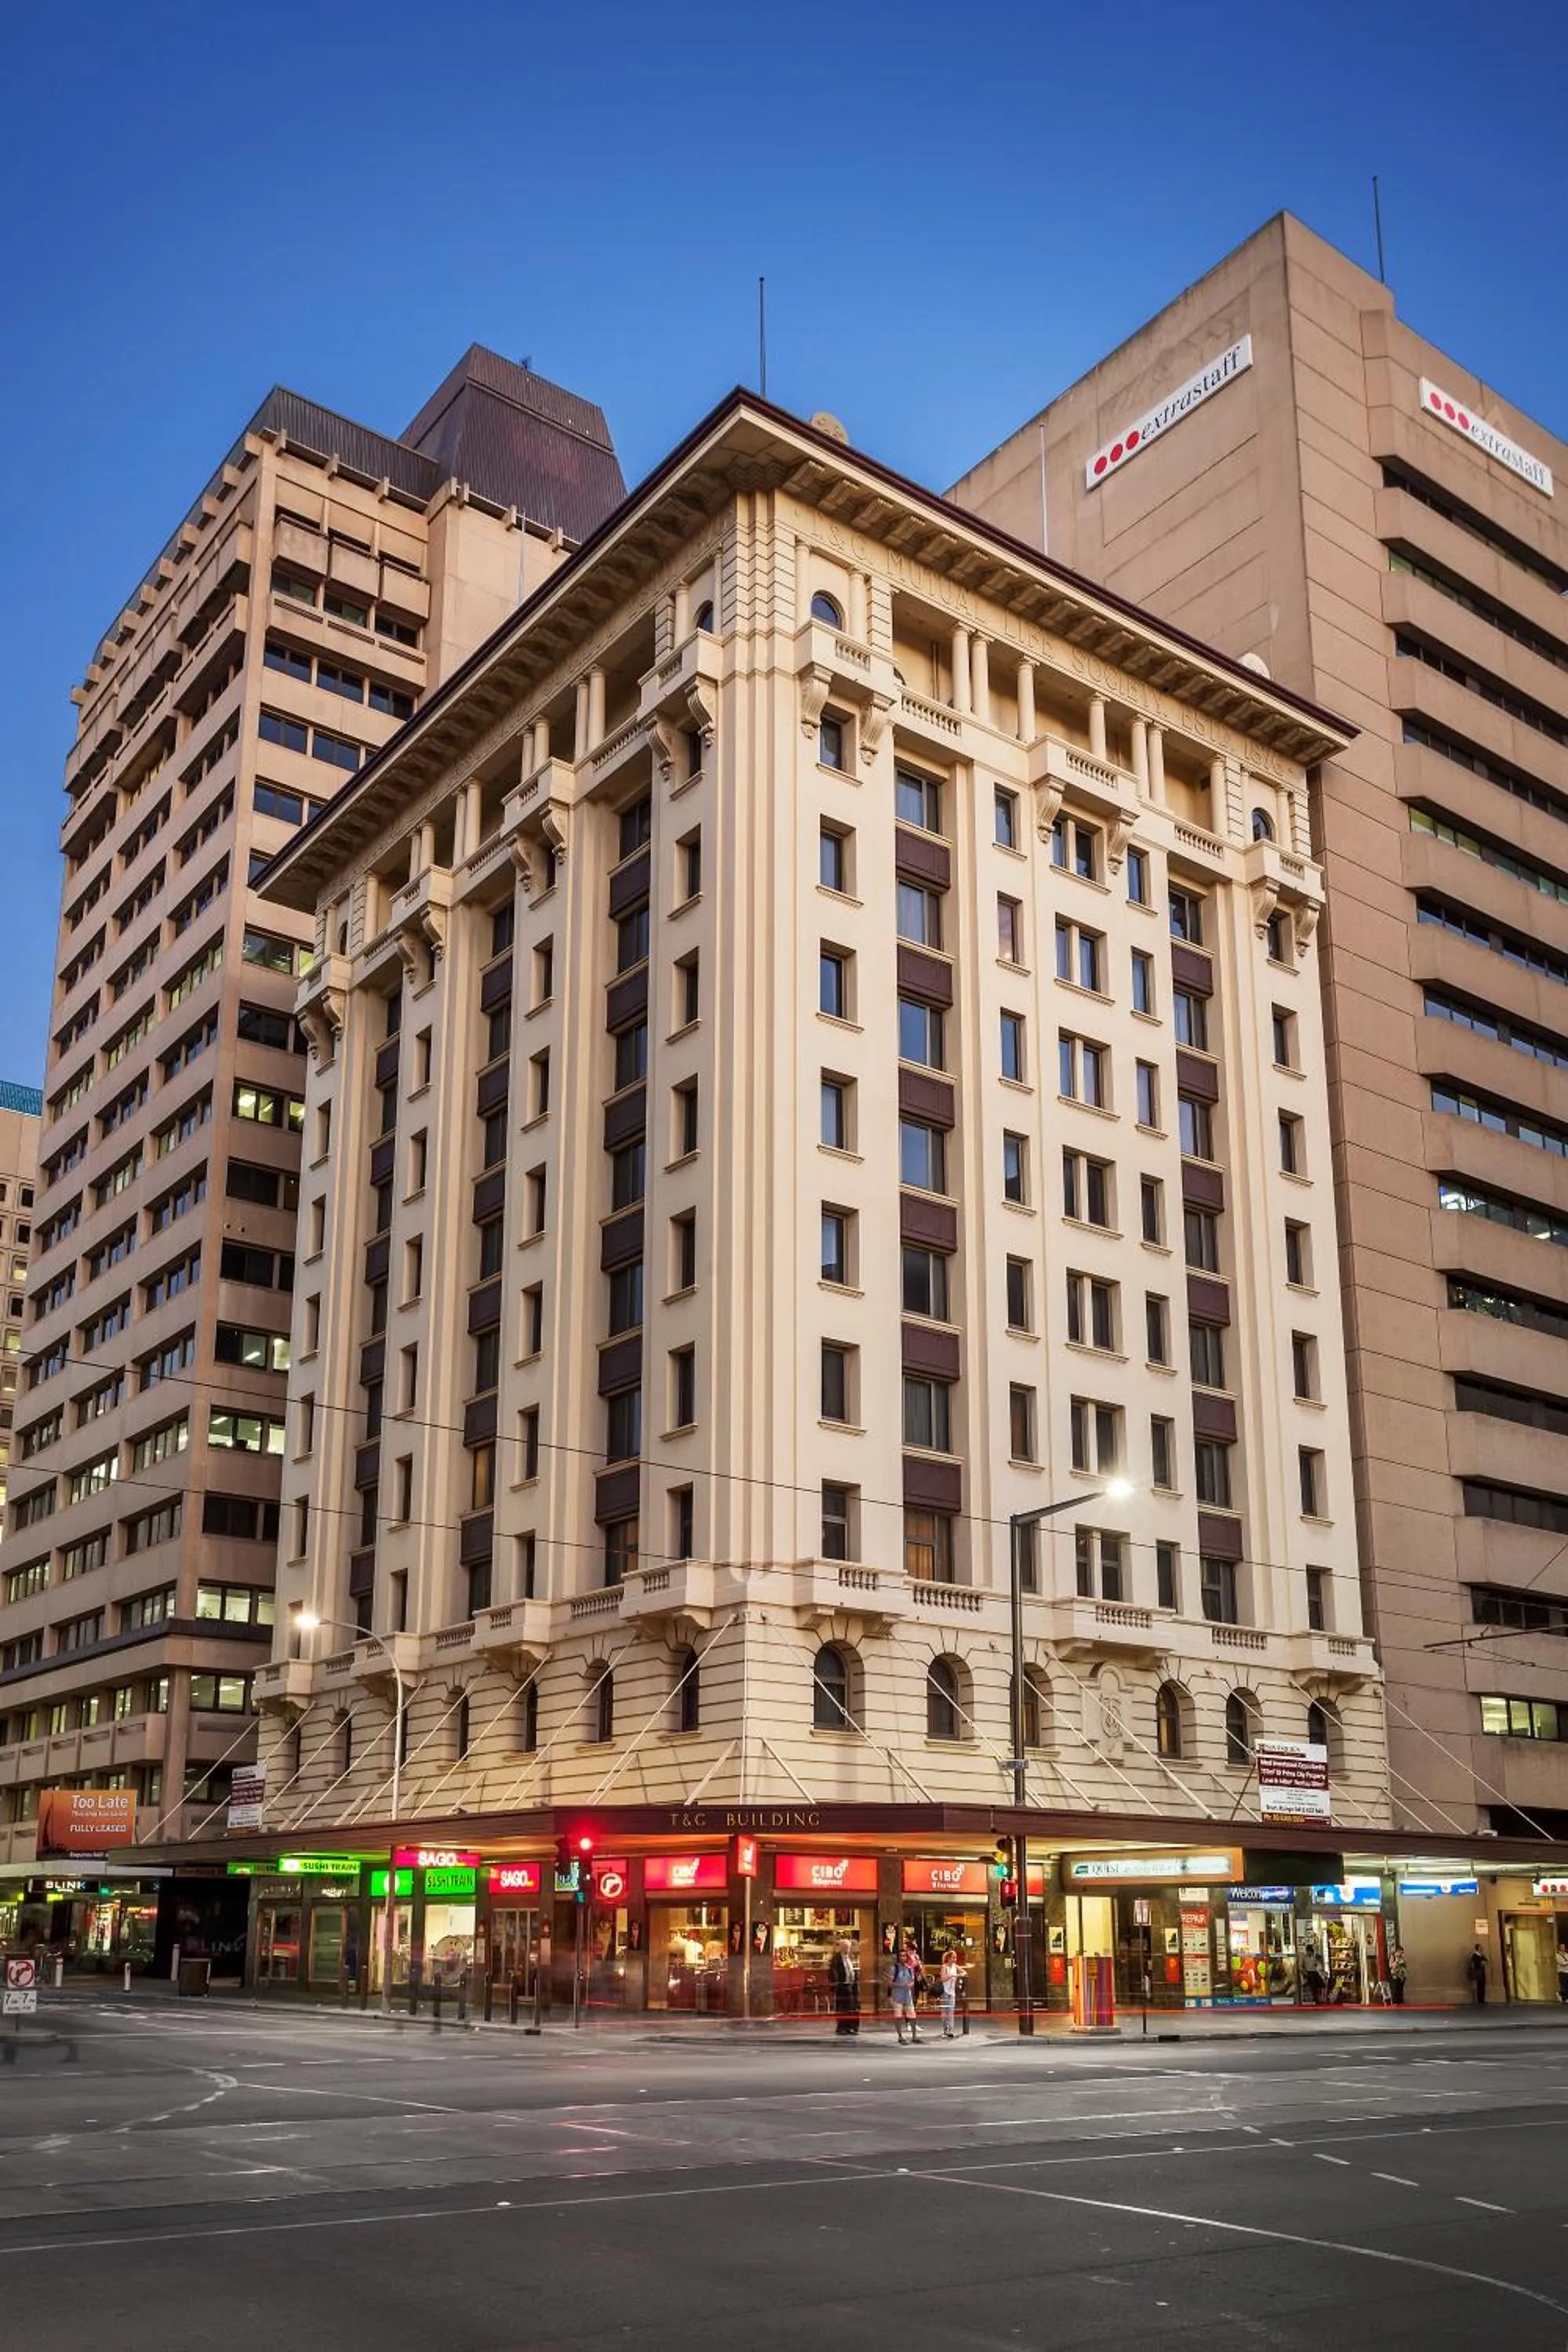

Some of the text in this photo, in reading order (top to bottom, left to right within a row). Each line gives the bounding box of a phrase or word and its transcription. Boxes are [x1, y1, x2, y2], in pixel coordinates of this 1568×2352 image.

[1141, 345, 1242, 440] extrastaff
[1471, 424, 1545, 485] extrastaff
[72, 1795, 128, 1809] Too Late
[727, 1813, 819, 1826] BUILDING
[417, 1851, 457, 1867] SAGO
[500, 1871, 528, 1887] SAGO
[811, 1865, 844, 1879] CIBO
[931, 1869, 960, 1882] CIBO
[45, 1881, 86, 1889] BLINK
[427, 1875, 474, 1888] SUSHI TRAIN
